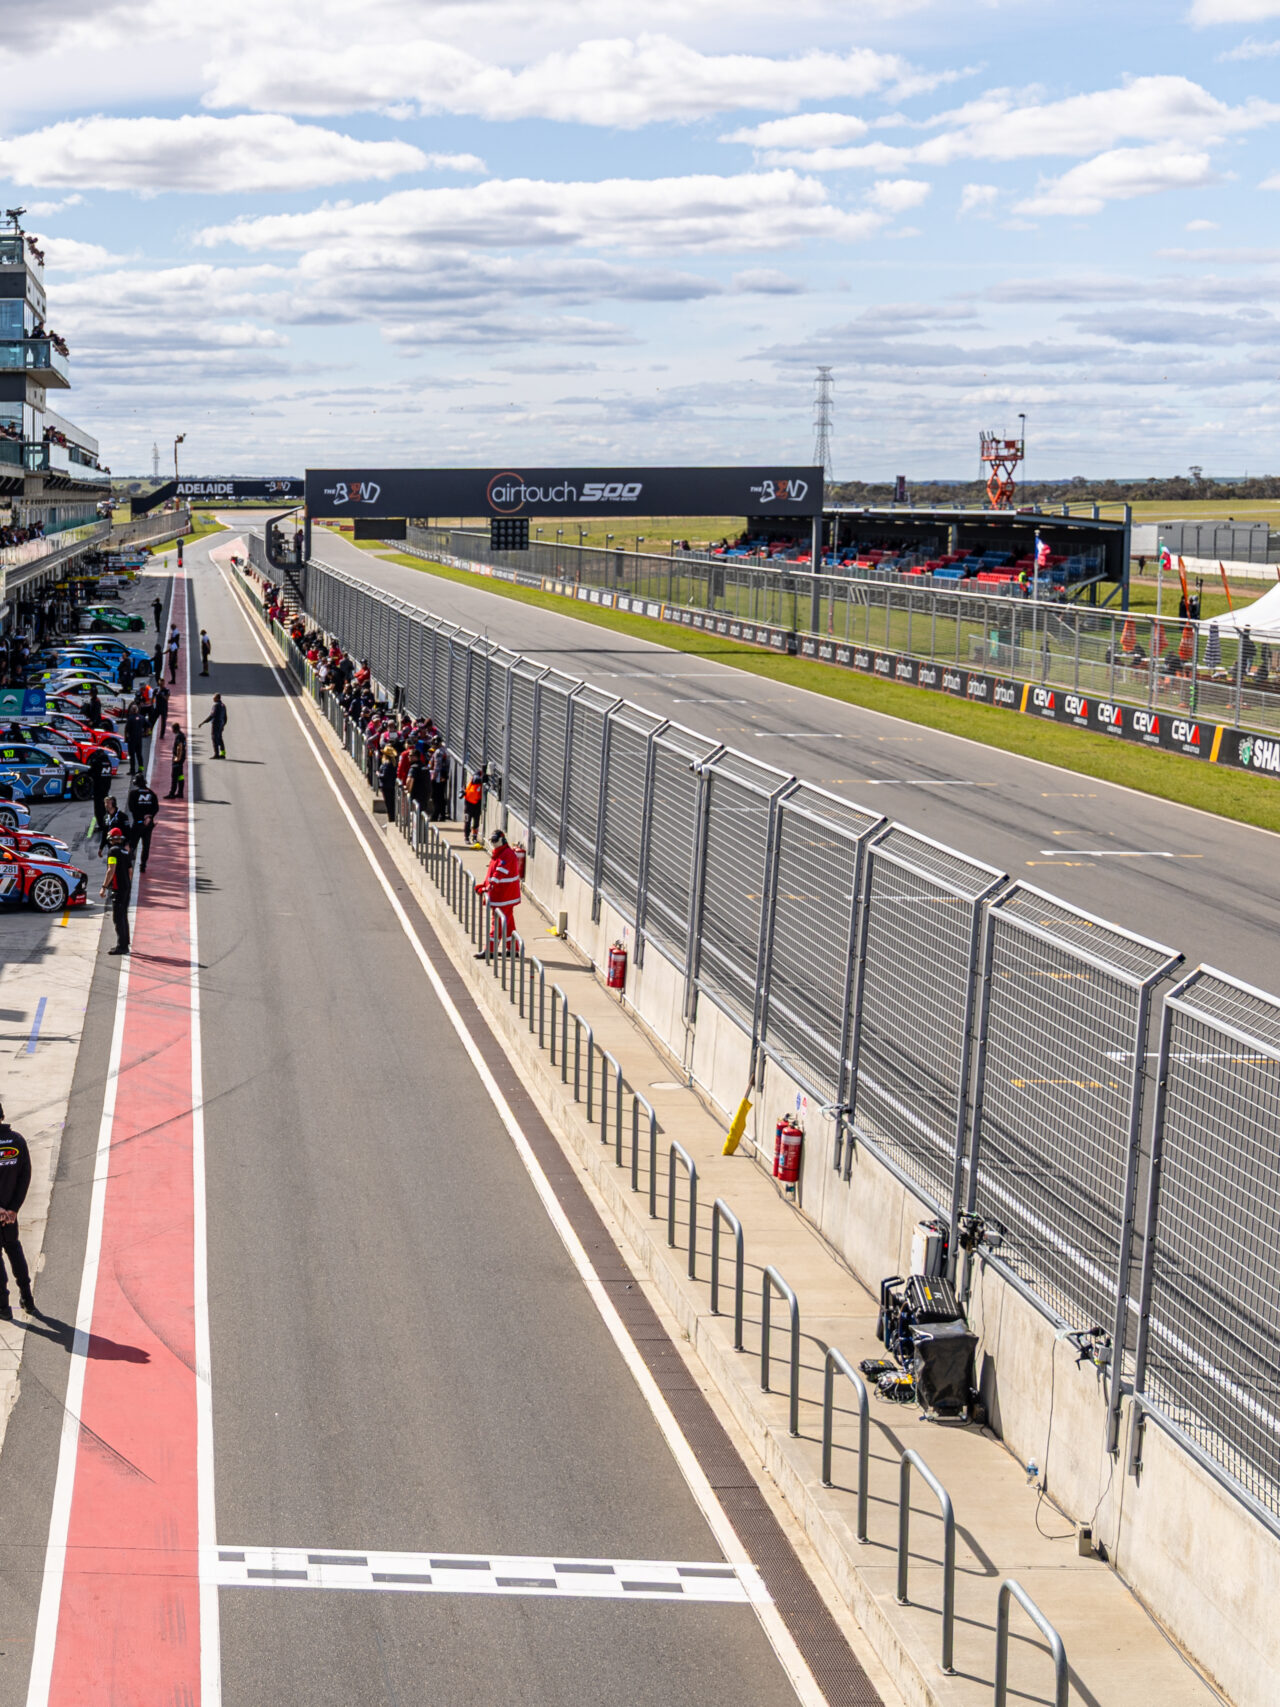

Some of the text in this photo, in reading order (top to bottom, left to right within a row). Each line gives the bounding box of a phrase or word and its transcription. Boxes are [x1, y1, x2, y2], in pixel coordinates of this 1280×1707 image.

[176, 483, 234, 494] ADELAIDE
[492, 481, 643, 502] airtouch 500
[995, 683, 1015, 704] airtouch
[4, 837, 14, 846] 30
[2, 865, 17, 873] 281
